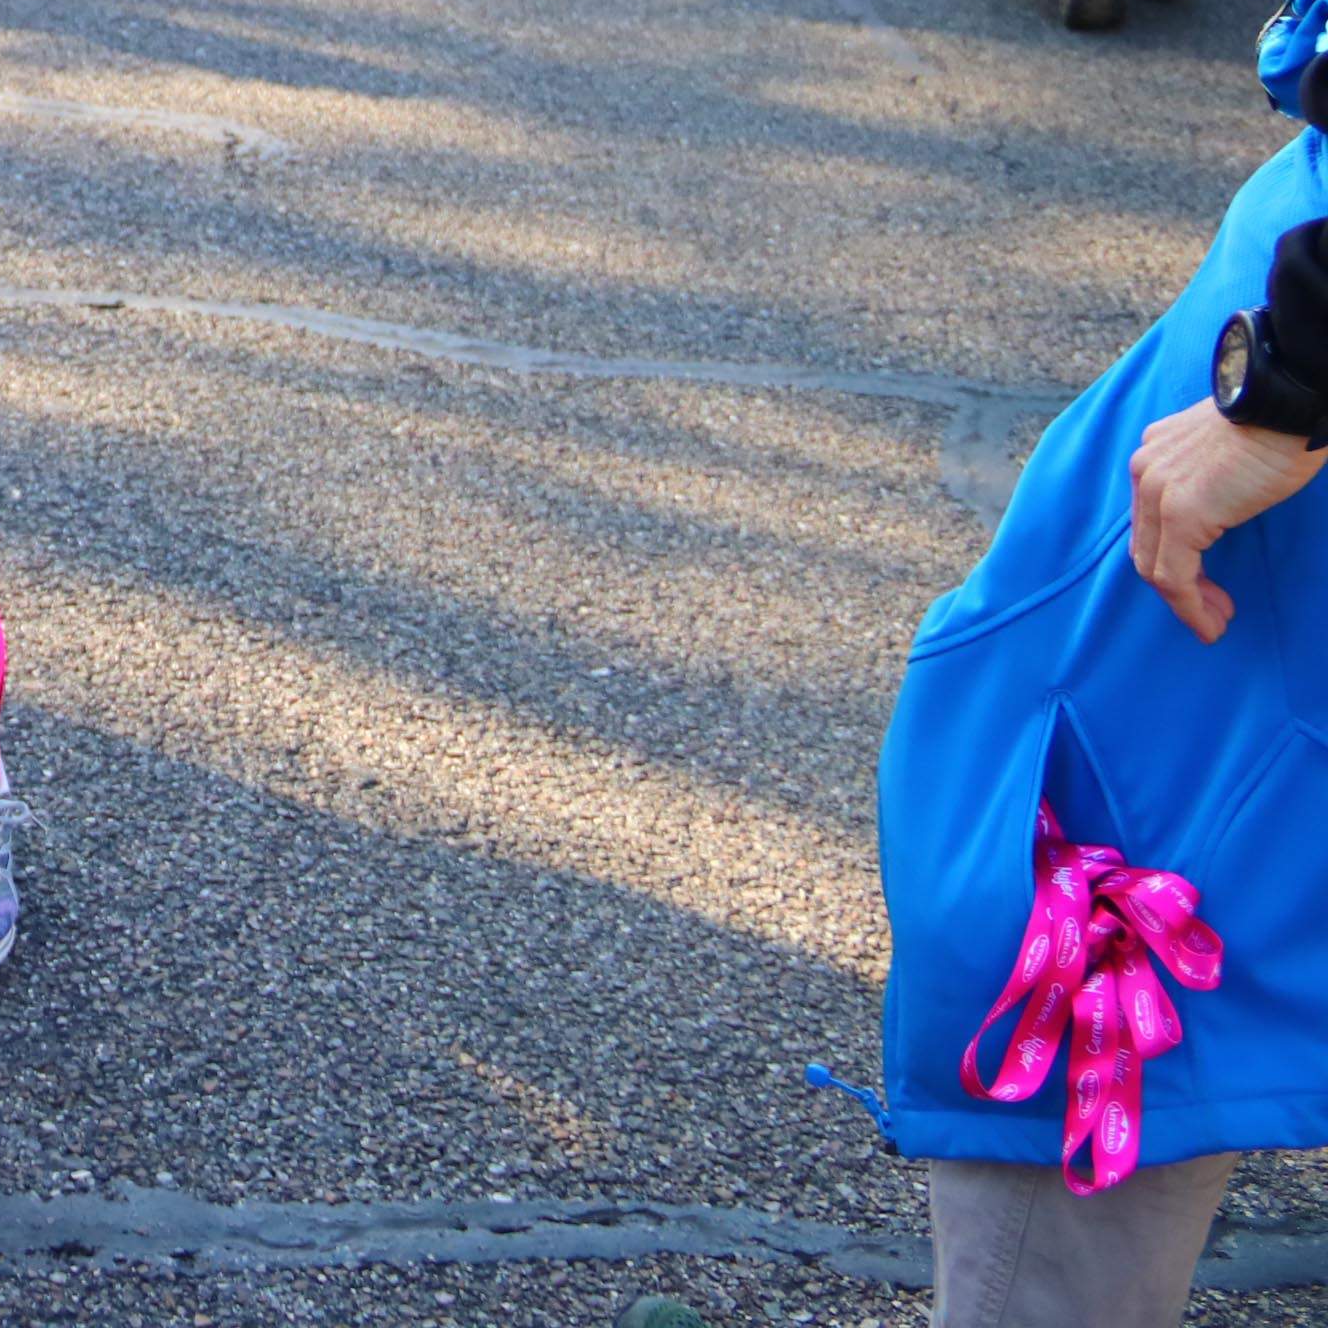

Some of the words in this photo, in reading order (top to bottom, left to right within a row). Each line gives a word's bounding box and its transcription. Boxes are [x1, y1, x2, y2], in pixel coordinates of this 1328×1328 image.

[1049, 866, 1077, 902] Mujer
[1085, 1006, 1104, 1055] Carrera
[1017, 1035, 1047, 1073] Mujer
